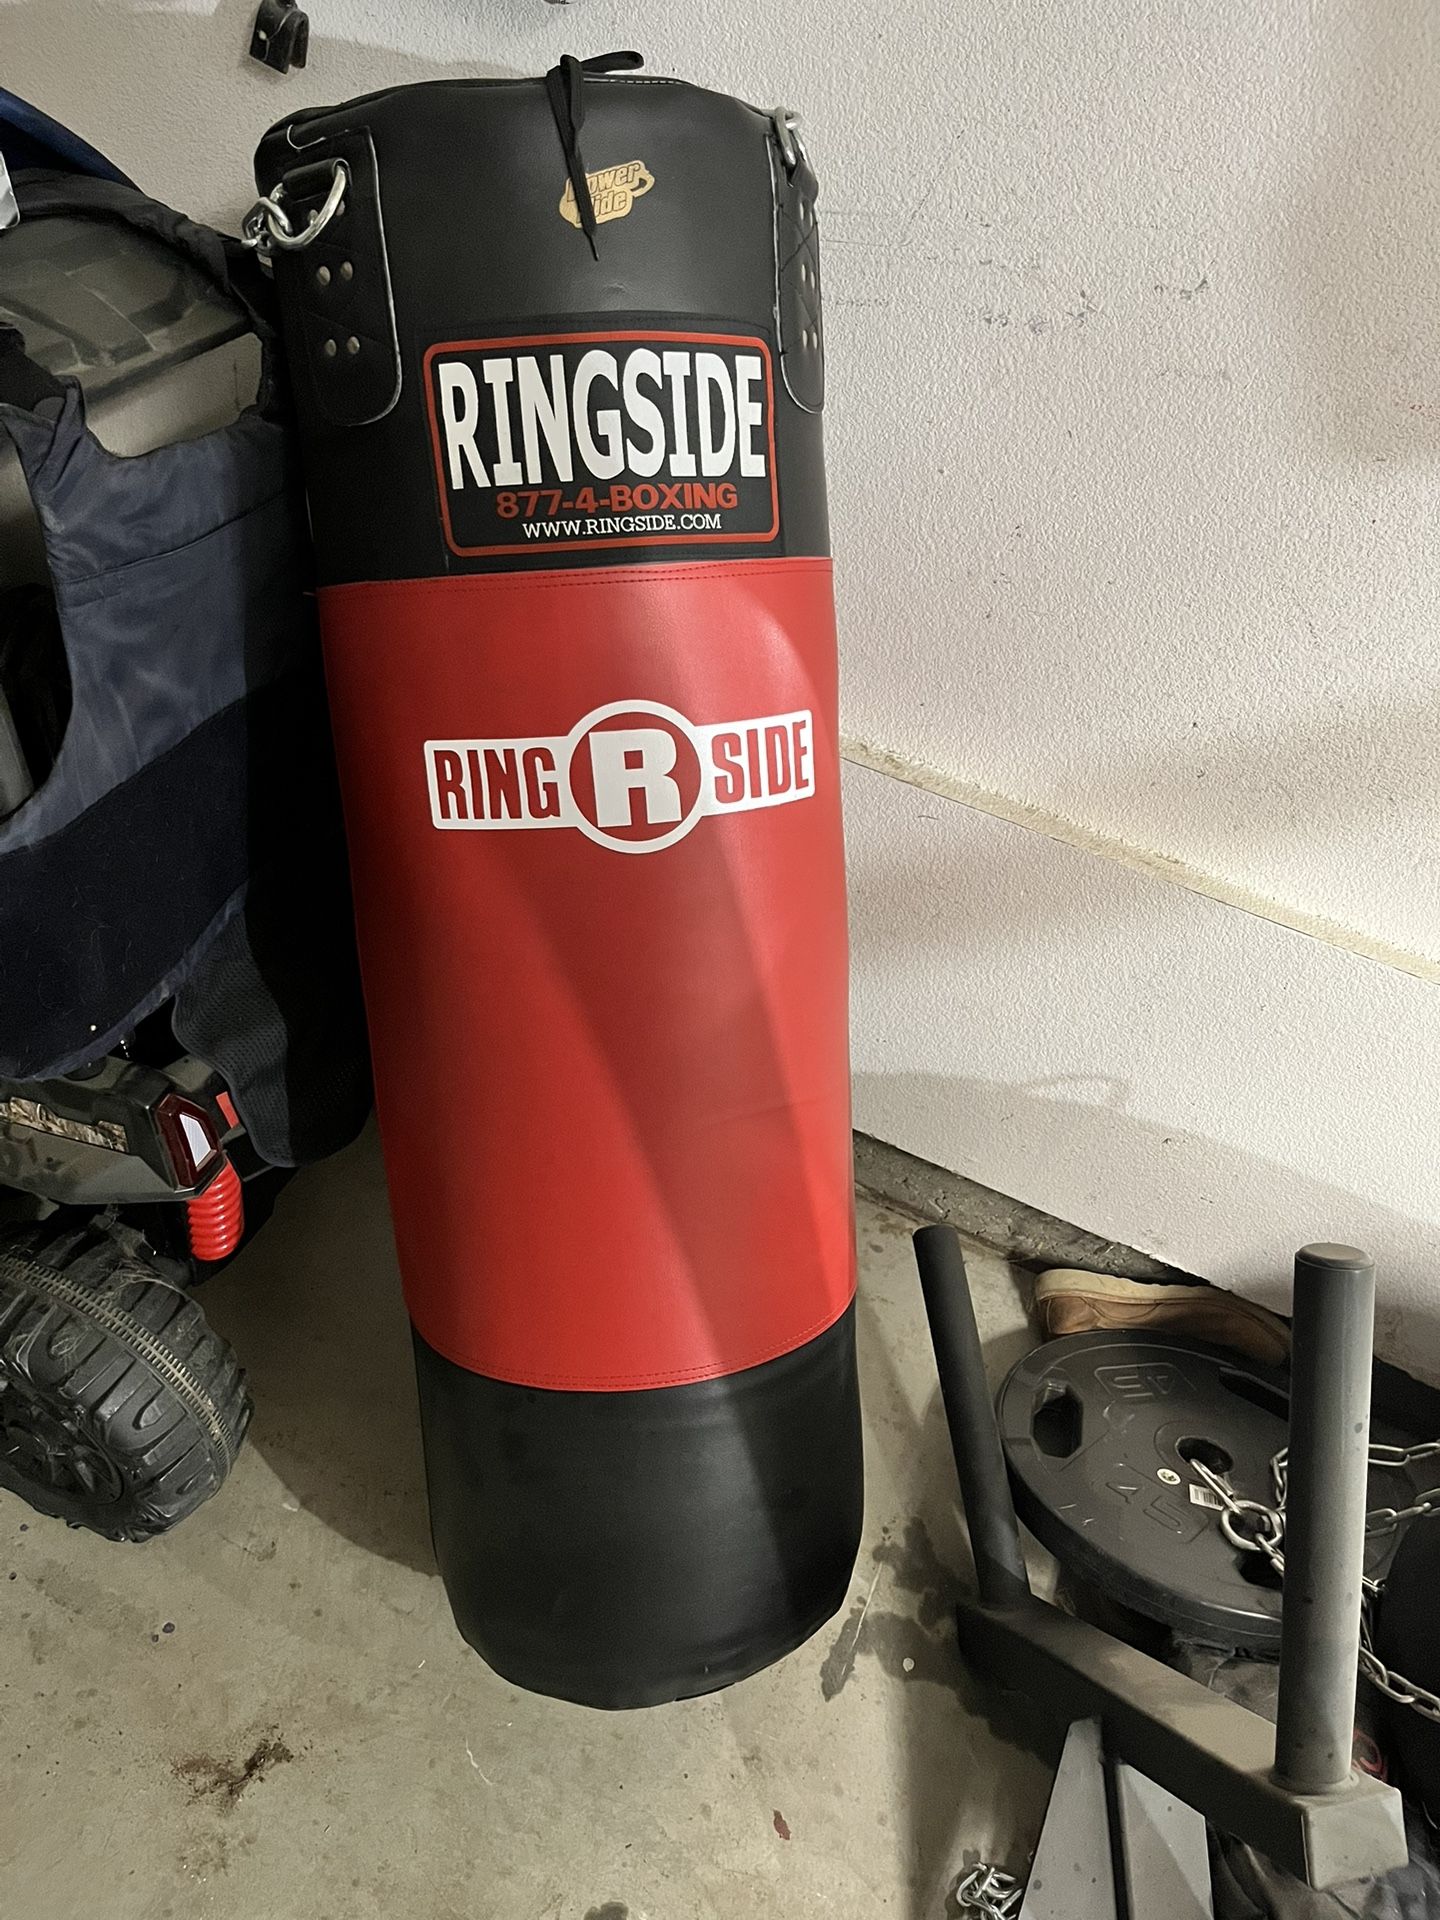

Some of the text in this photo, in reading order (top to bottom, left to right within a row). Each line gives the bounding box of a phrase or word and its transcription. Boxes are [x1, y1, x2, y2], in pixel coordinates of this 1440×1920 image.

[566, 163, 640, 203] ower
[576, 189, 627, 223] ide
[438, 347, 766, 490] RINGSIDE
[496, 483, 738, 519] 877-4-BOXING
[522, 514, 722, 539] WWW.RINGSIDE.COM
[433, 720, 809, 828] RING R SIDE
